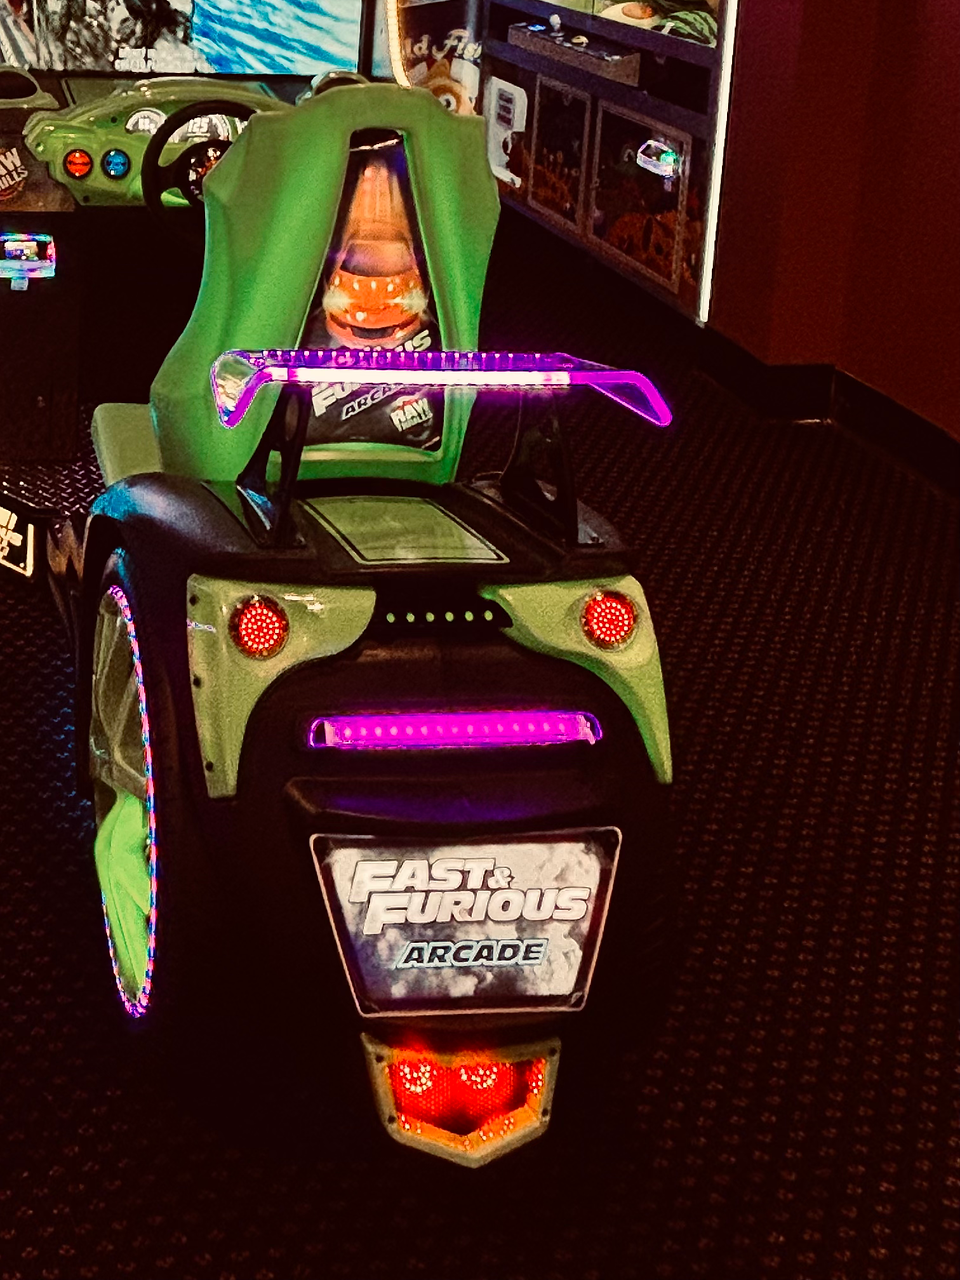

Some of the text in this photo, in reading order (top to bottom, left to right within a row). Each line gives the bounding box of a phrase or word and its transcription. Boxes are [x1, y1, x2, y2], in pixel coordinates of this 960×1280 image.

[390, 397, 432, 427] RAW
[362, 887, 592, 936] FURIOUS
[394, 938, 550, 970] ARCADE
